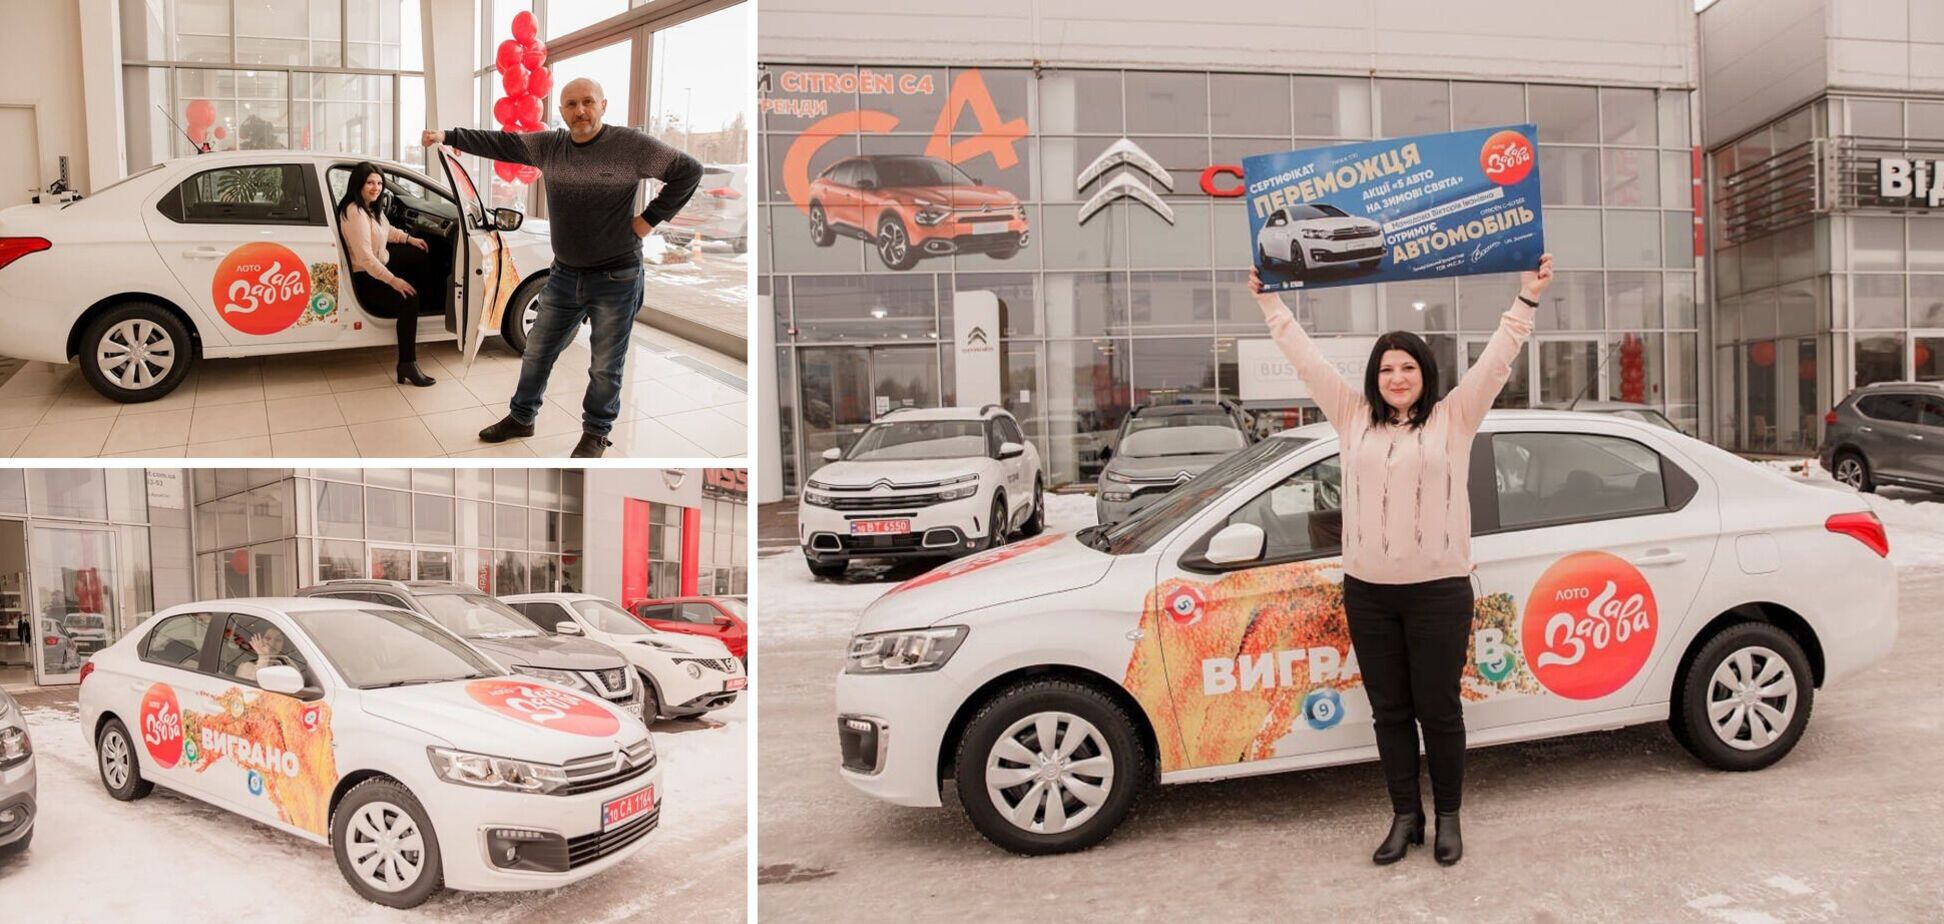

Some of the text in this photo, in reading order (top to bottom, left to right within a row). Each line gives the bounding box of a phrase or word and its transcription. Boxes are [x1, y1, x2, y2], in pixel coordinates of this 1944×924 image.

[780, 69, 894, 94] CITROËN
[899, 74, 933, 95] C4
[758, 98, 828, 118] РЕНДИ
[1249, 163, 1315, 194] СЕРТИФІКАТ
[1253, 143, 1421, 218] ПЕРЕМОЖЦЯ
[1362, 181, 1391, 200] АКЦІЇ
[1406, 169, 1434, 186] АВТО
[1365, 202, 1382, 214] НА
[1382, 187, 1423, 208] ЗИМОВІ
[1387, 222, 1438, 245] ОТРИМУЄ
[1393, 206, 1534, 264] АВТОМОБІЛЬ
[236, 264, 261, 272] ЛОТО
[224, 261, 305, 314] Забава
[1555, 587, 1590, 600] ЛОТО
[1537, 580, 1650, 668] Забава
[1202, 628, 1505, 696] ВИГРА В
[201, 726, 299, 778] ВИГРАНО
